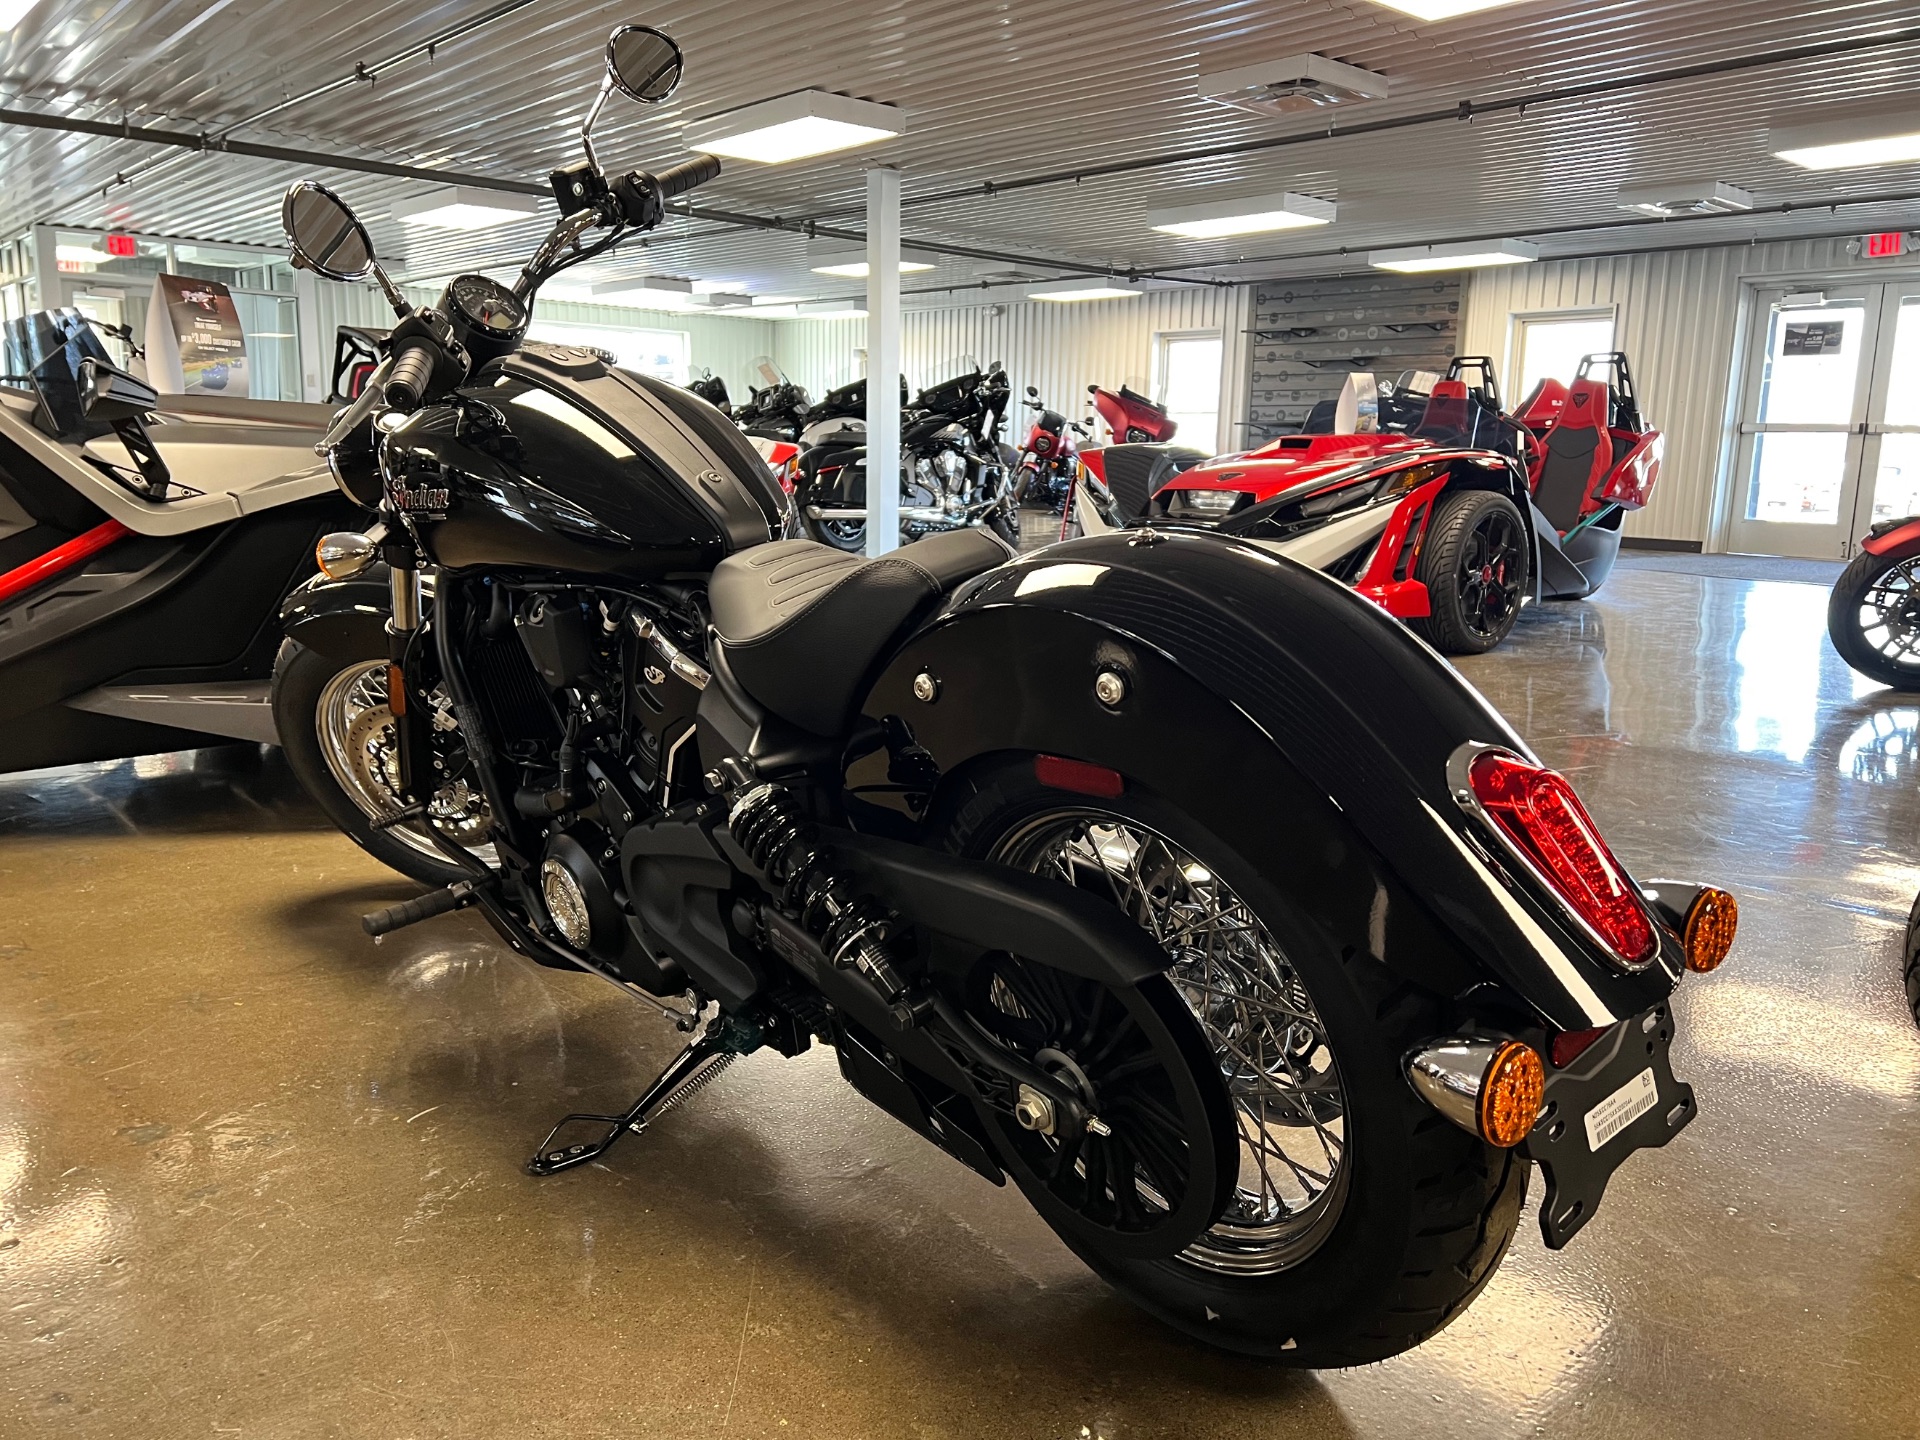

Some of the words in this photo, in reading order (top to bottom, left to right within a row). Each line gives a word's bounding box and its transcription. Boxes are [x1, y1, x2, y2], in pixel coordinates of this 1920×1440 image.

[108, 235, 136, 257] EXIT
[1869, 232, 1901, 257] EXIT
[392, 474, 450, 509] Indian
